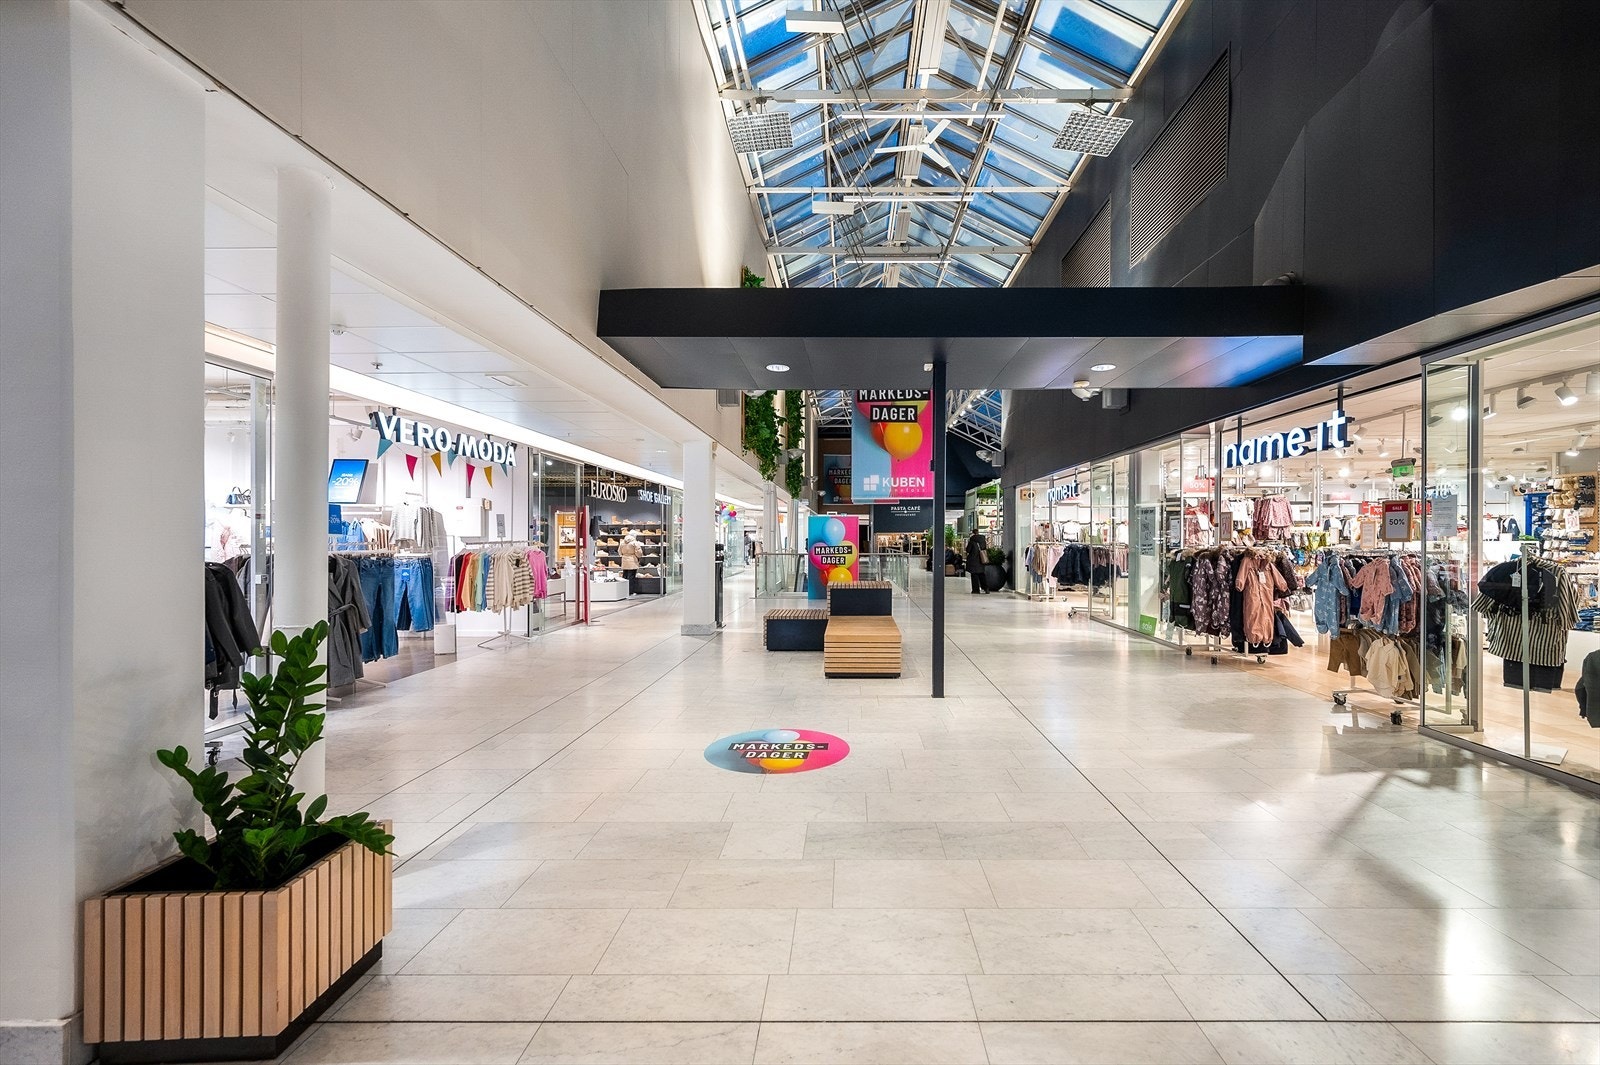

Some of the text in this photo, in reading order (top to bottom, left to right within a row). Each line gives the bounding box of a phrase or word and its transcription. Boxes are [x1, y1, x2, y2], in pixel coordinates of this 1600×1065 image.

[859, 389, 928, 400] MARKEDS-
[872, 407, 915, 420] DAGER
[377, 411, 517, 467] VERO MODA
[1223, 410, 1346, 469] name it
[882, 477, 925, 487] KUBEN
[590, 480, 628, 503] EUROSKO
[639, 490, 654, 502] SHOE
[1389, 518, 1405, 526] 50%
[815, 546, 851, 555] MARKEDS-
[822, 556, 845, 564] DAGER
[732, 743, 824, 751] MARKEDS-
[745, 751, 806, 759] DAGER
